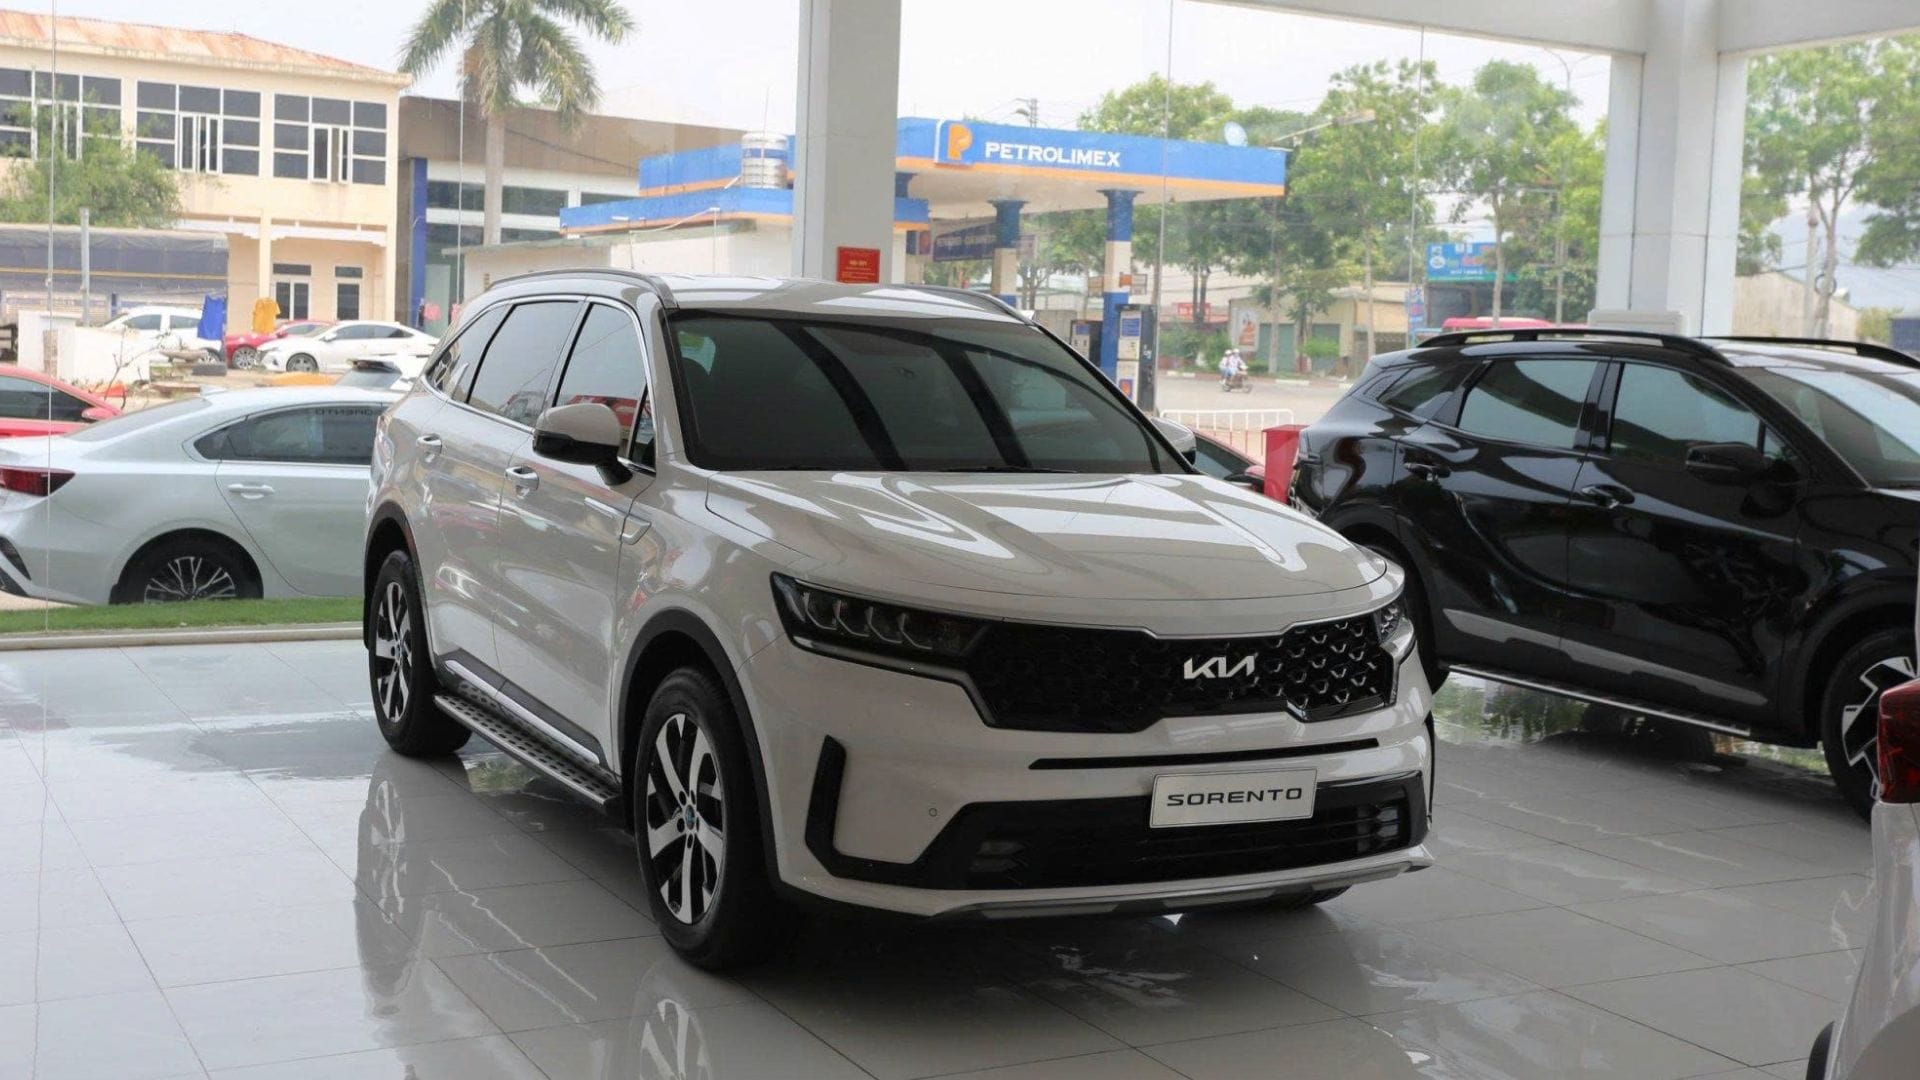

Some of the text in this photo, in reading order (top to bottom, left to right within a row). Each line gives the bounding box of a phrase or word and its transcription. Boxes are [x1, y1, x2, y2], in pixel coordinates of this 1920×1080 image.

[985, 141, 1121, 167] PETROLIMEX
[1184, 655, 1256, 680] KIA
[1167, 787, 1302, 806] SORENTO
